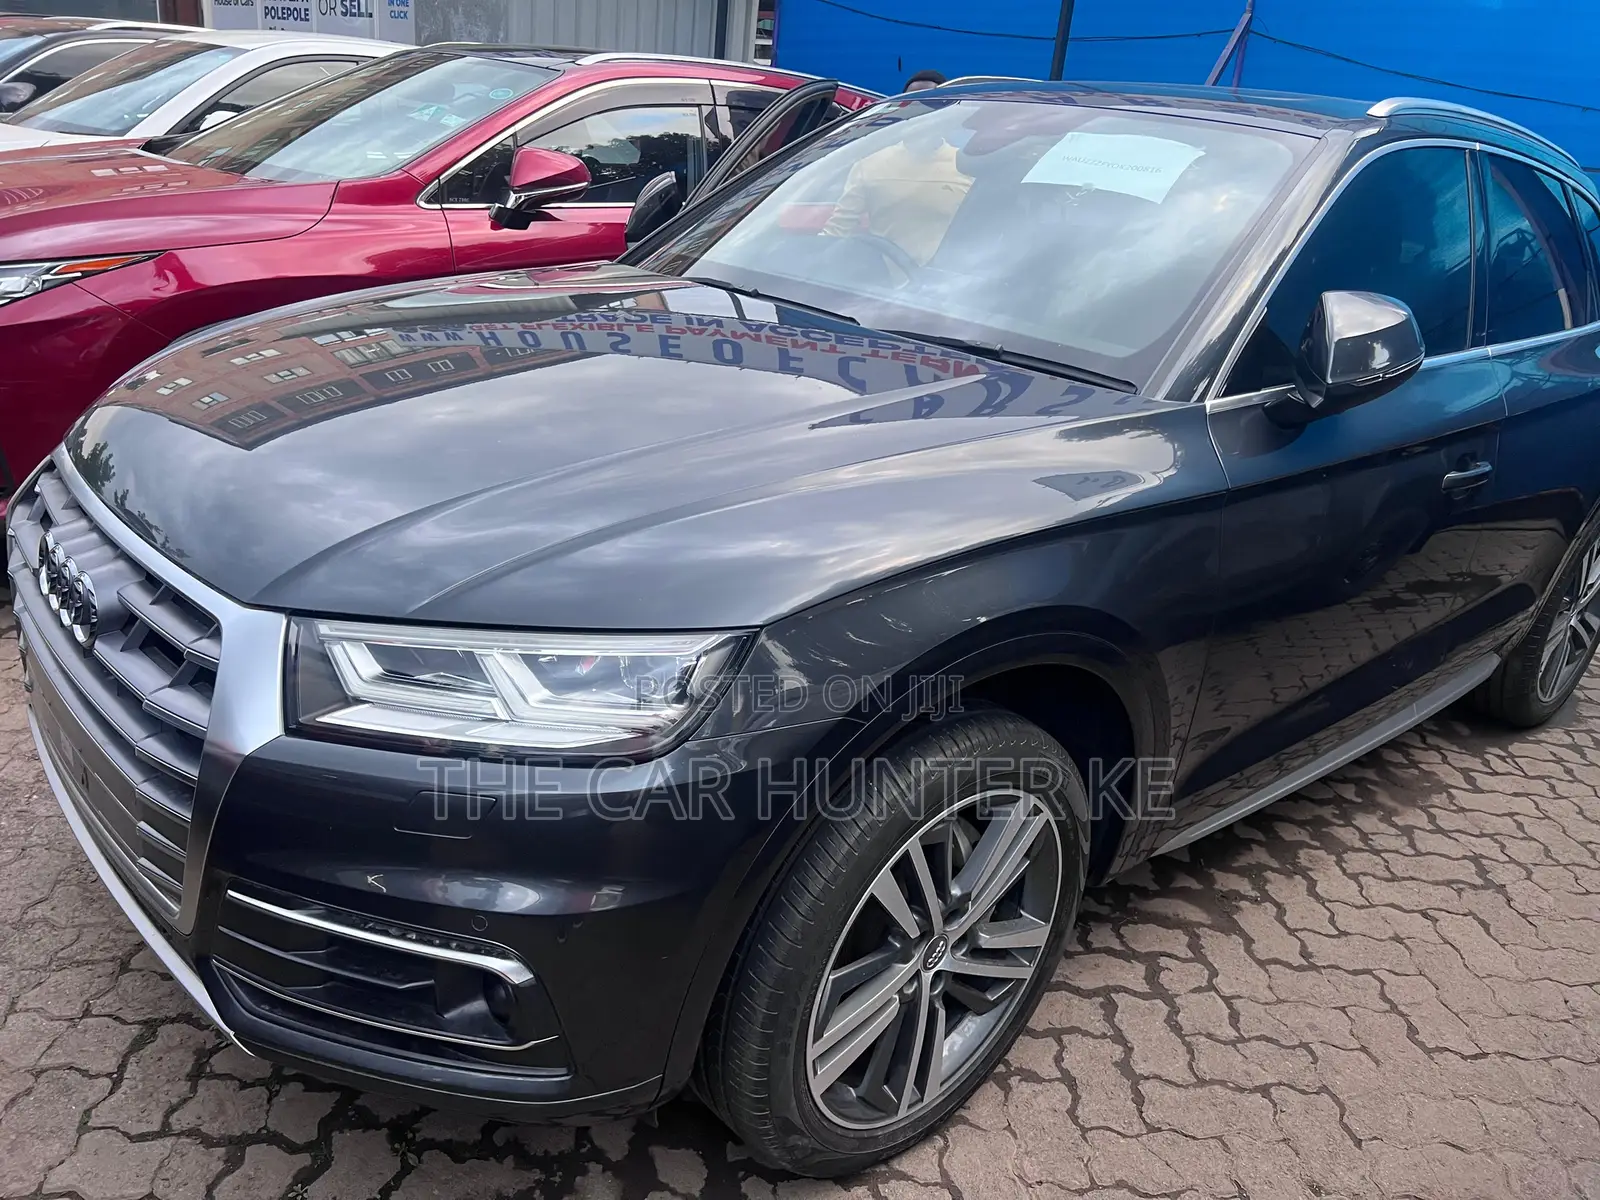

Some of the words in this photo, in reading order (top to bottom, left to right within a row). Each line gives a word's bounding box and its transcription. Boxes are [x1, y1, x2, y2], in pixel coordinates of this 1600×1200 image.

[318, 0, 337, 16] OR
[340, 0, 373, 18] SELL
[396, 0, 410, 8] ONE
[264, 6, 310, 22] POLEPOLE
[389, 10, 409, 20] CLICK
